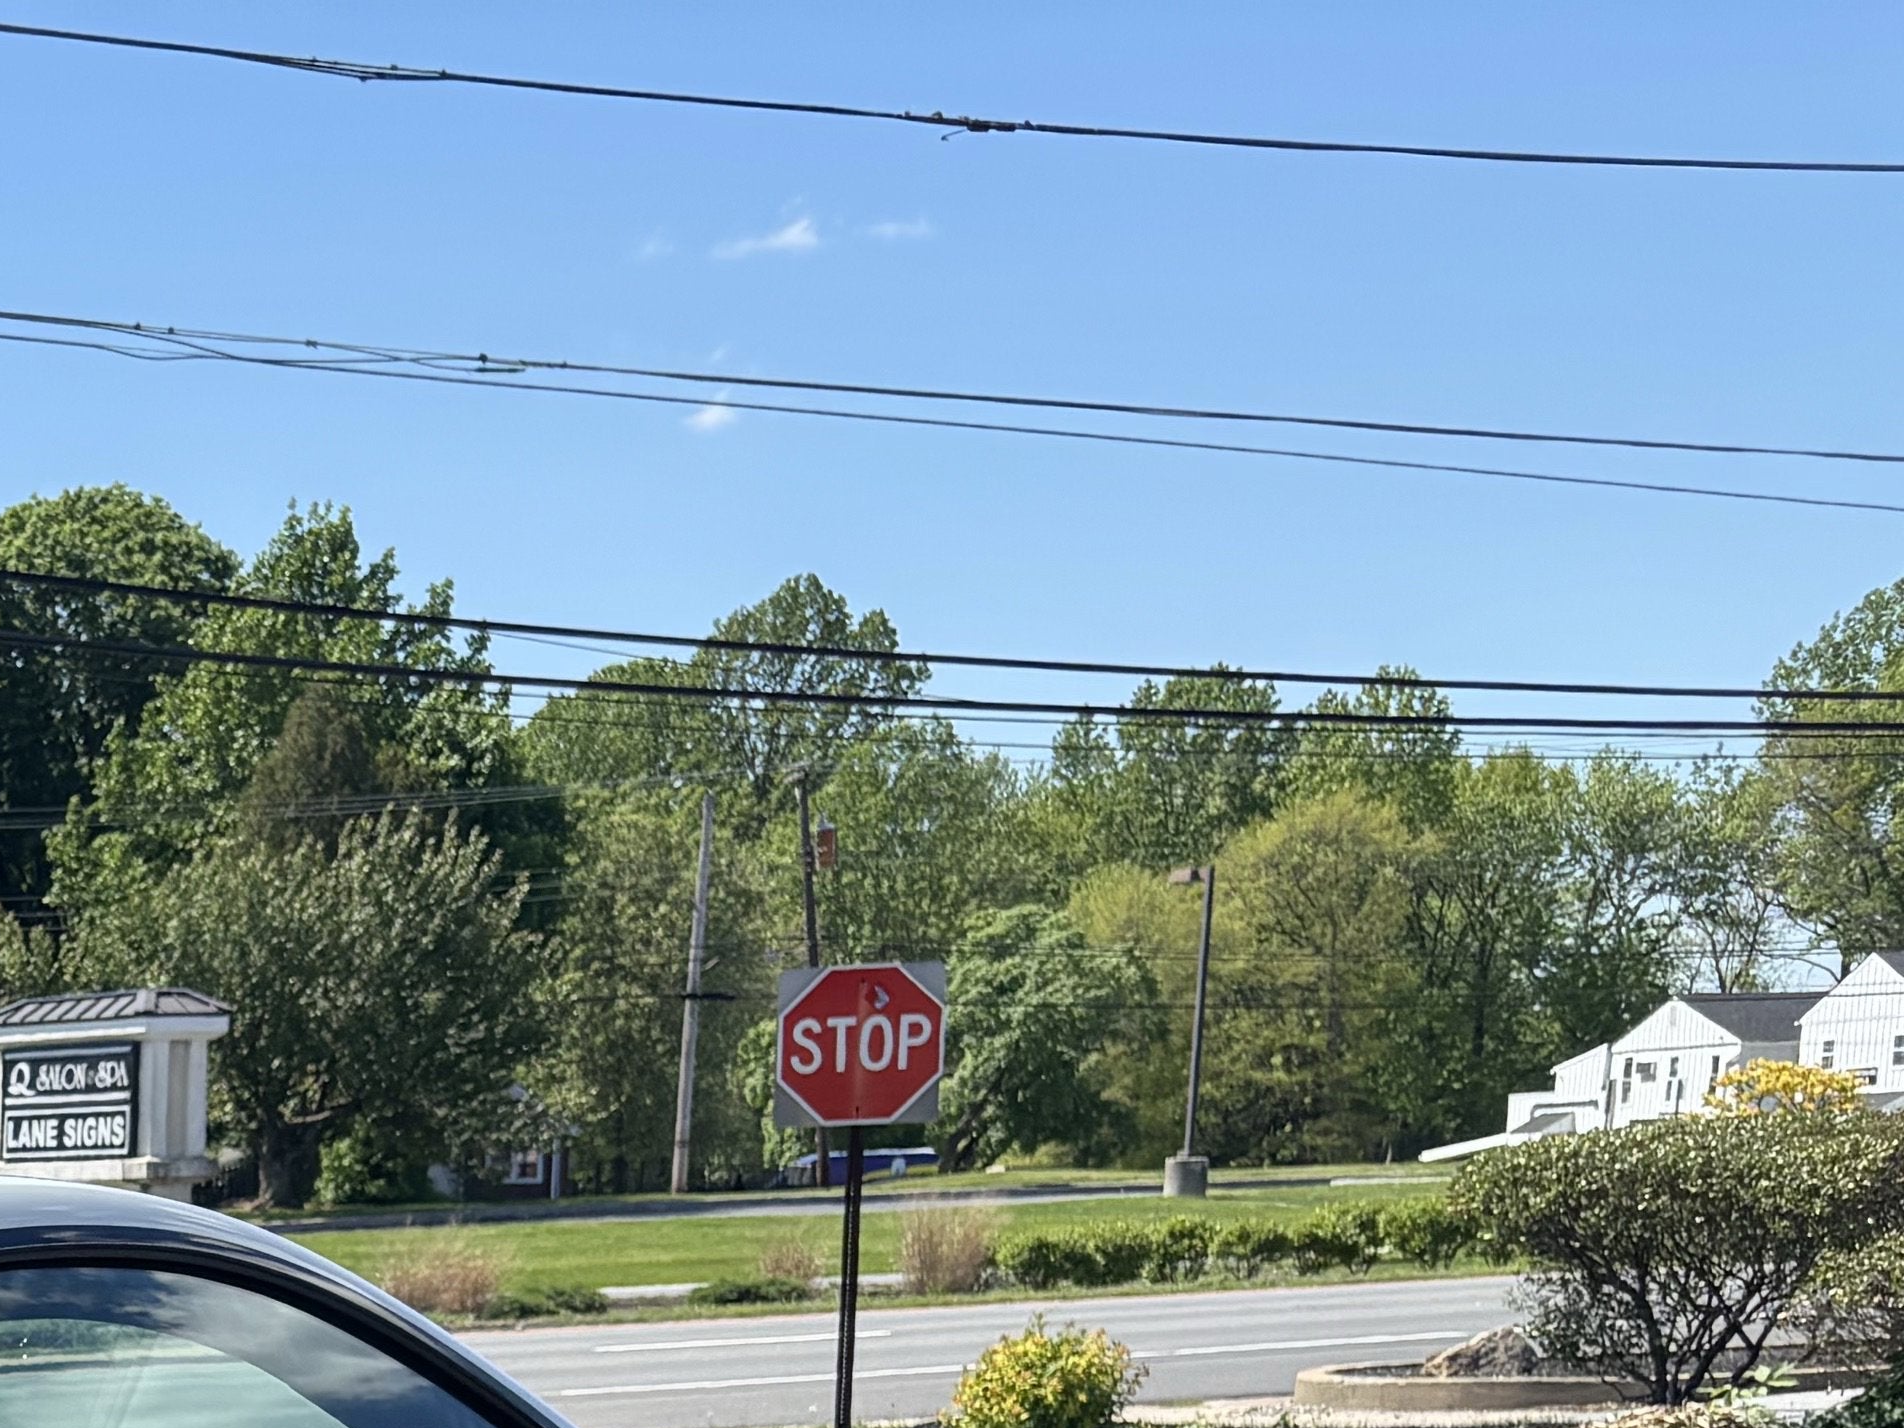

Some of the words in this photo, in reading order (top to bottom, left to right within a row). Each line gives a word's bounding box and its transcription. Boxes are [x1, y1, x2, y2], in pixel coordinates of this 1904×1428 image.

[790, 1013, 932, 1075] STOP
[8, 1062, 36, 1096] Q
[95, 1060, 129, 1089] SPA
[7, 1119, 58, 1149] LANE
[63, 1115, 125, 1147] SIGNS
